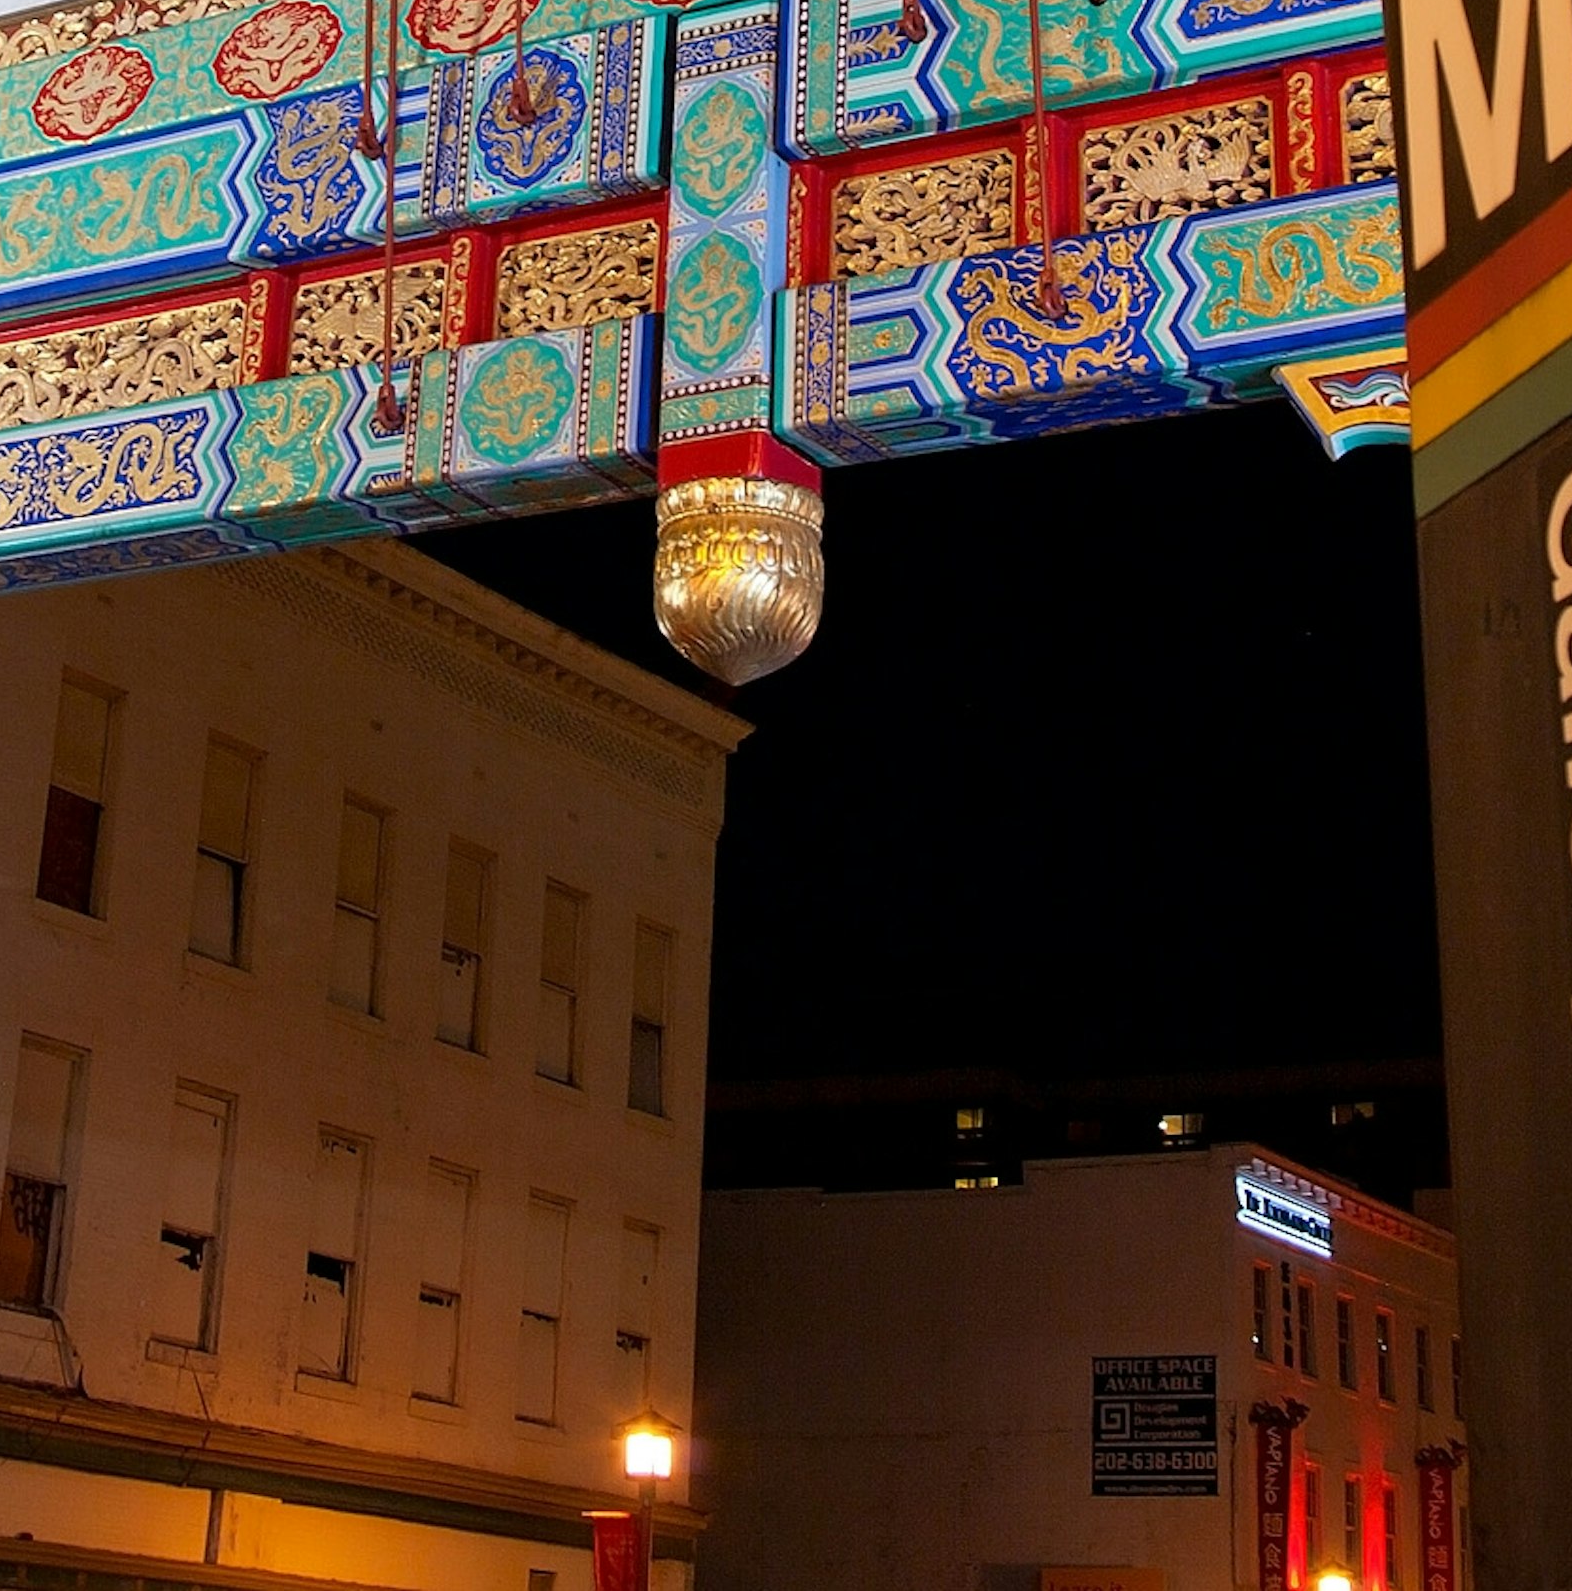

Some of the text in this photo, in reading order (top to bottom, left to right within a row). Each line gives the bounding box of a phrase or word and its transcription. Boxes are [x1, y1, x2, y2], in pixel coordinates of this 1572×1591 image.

[1095, 1358, 1213, 1375] OFFICE SPACE
[1105, 1375, 1203, 1391] AVAILABLE
[1135, 1415, 1206, 1426] Development
[1095, 1451, 1216, 1470] 202-638-6300
